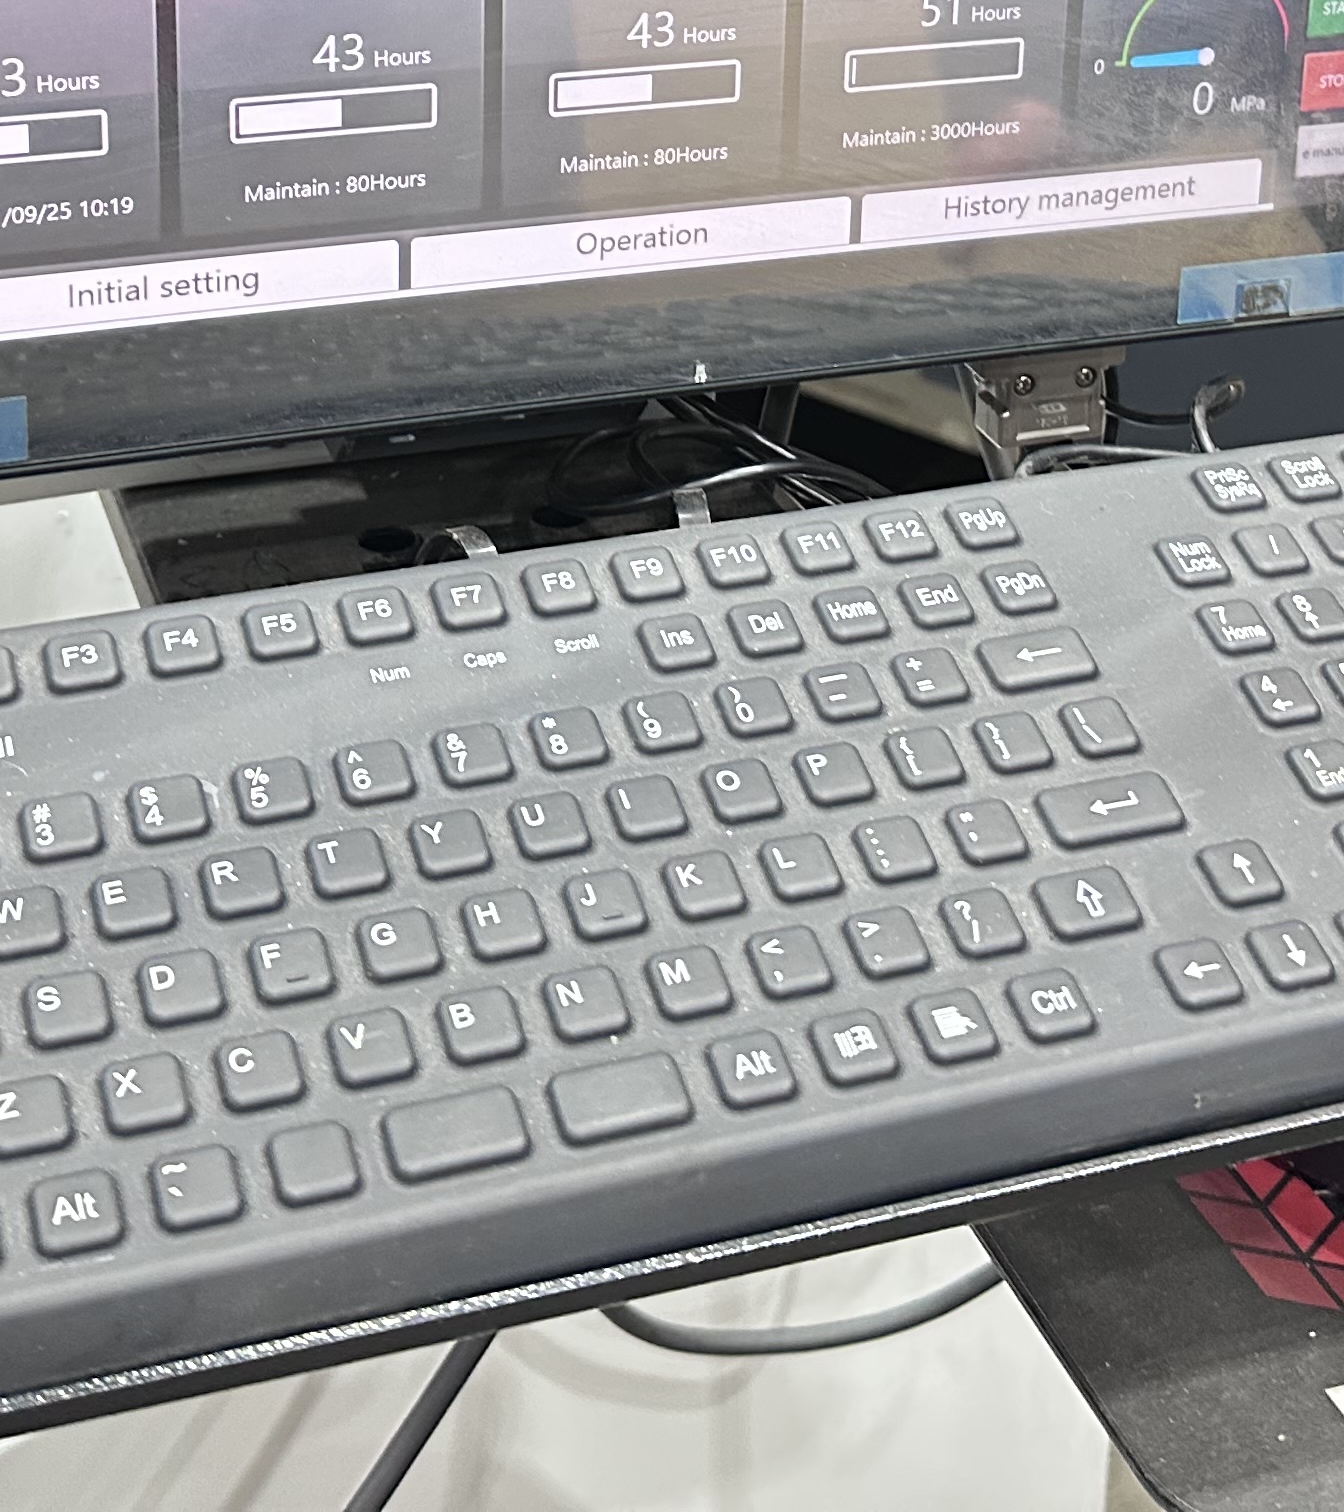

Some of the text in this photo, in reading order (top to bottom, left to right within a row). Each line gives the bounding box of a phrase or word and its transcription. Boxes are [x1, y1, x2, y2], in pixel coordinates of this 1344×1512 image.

[971, 2, 1022, 22] Hours
[627, 11, 737, 48] 43 Hours
[312, 34, 431, 72] 43 Hours
[37, 70, 100, 94] Hours
[1231, 96, 1265, 113] MPa
[842, 117, 1020, 150] Maintain 3000Hours
[560, 143, 729, 175] Maintain 80Hours
[244, 169, 427, 203] Maintain 80Hours
[79, 194, 134, 219] 10:19
[943, 176, 1197, 224] History management
[576, 220, 709, 259] Operation
[68, 267, 261, 310] Initial setting
[878, 518, 925, 543] F12
[959, 508, 1007, 534] PgUp
[797, 530, 842, 556] F11
[629, 556, 664, 580] F9
[710, 544, 758, 569] F10
[541, 570, 576, 594] F8
[995, 570, 1045, 598] PgDn
[450, 584, 483, 608] F7
[916, 583, 959, 607] End
[357, 598, 393, 622] F6
[827, 597, 877, 624] Home
[261, 613, 297, 637] F5
[748, 611, 785, 635] Del
[163, 628, 199, 652] F4
[554, 632, 599, 654] Scroll
[660, 627, 694, 649] Ins
[61, 644, 98, 668] F3
[463, 648, 507, 670] Caps
[370, 664, 411, 683] Num
[52, 1193, 99, 1225] Alt
